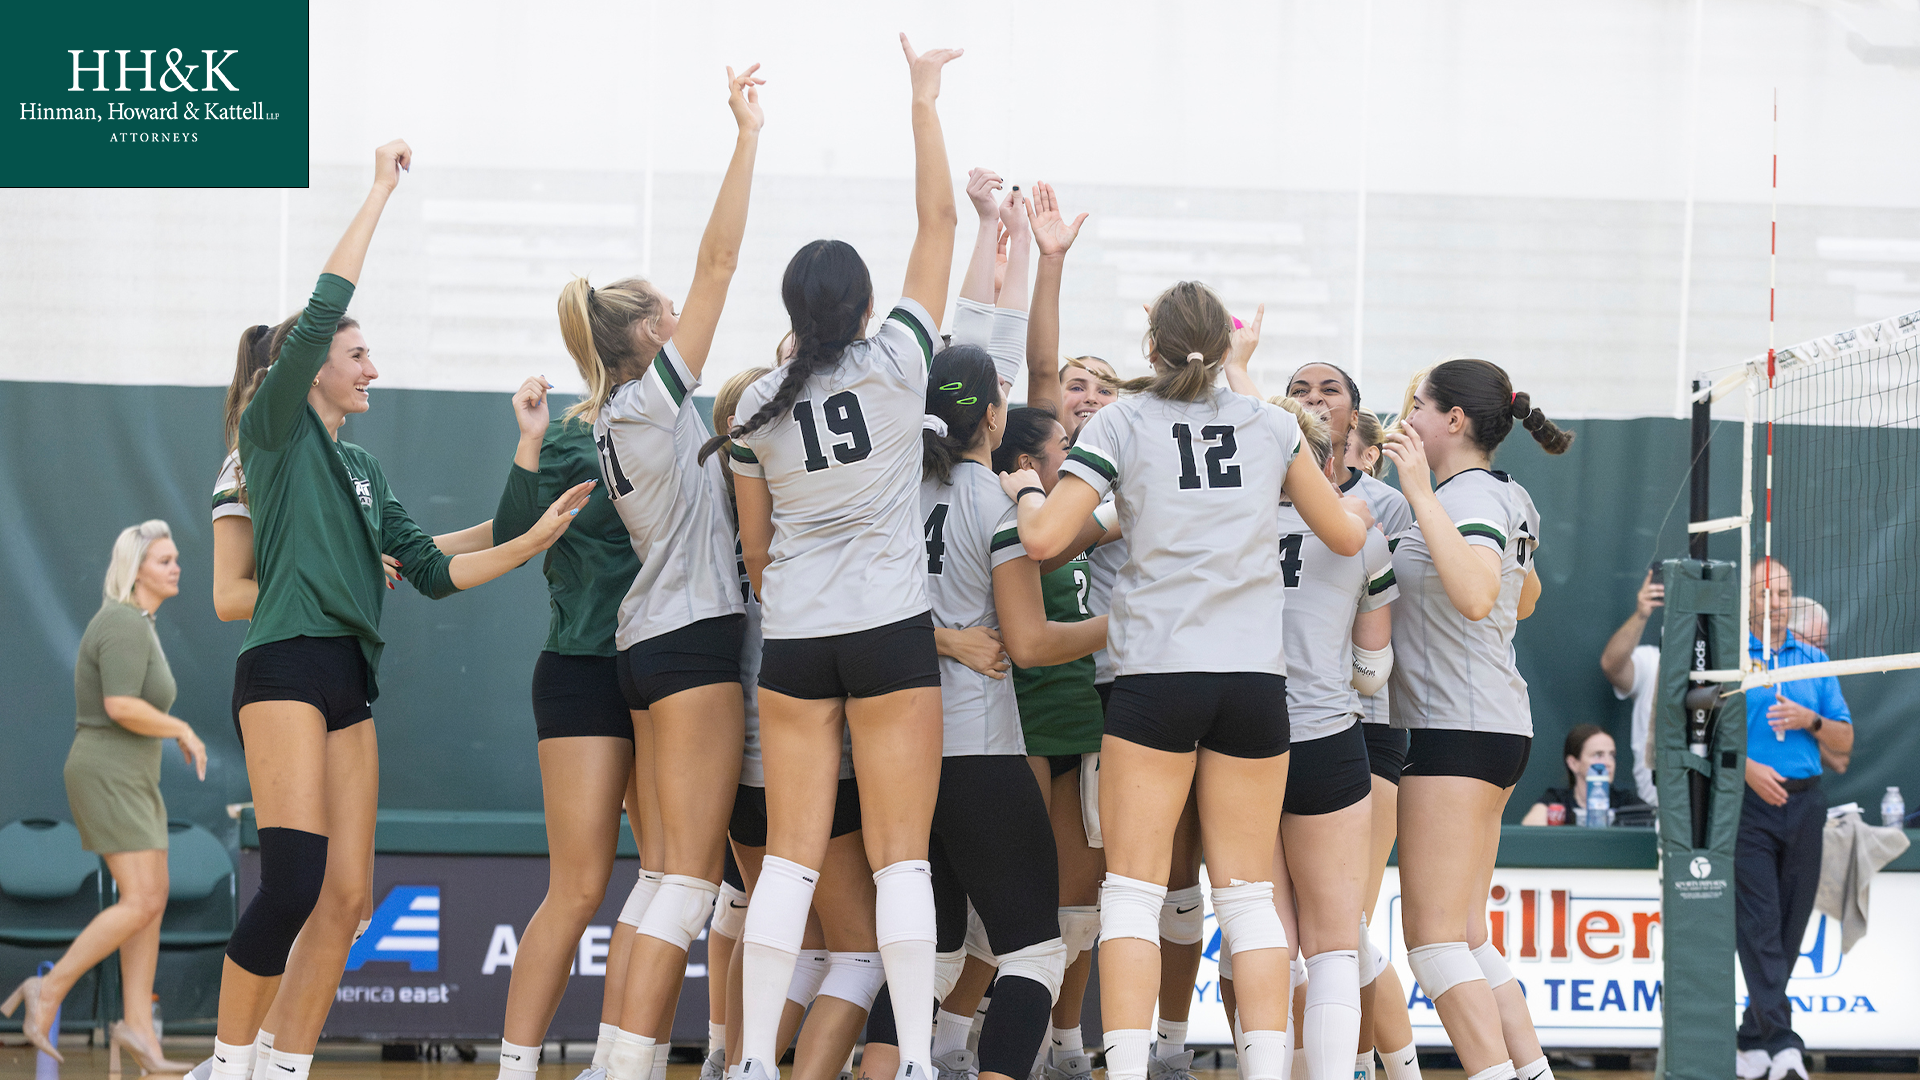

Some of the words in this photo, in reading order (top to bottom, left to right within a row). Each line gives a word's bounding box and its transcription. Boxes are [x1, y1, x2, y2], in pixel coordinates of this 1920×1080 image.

[791, 389, 873, 475] 19
[1170, 421, 1244, 491] 12
[923, 502, 951, 577] 4
[1073, 569, 1088, 615] 2
[1489, 884, 1661, 960] iller
[337, 985, 395, 1003] erica
[398, 983, 449, 1003] east
[1544, 979, 1663, 1012] TEAM
[1736, 995, 1878, 1013] NDA
